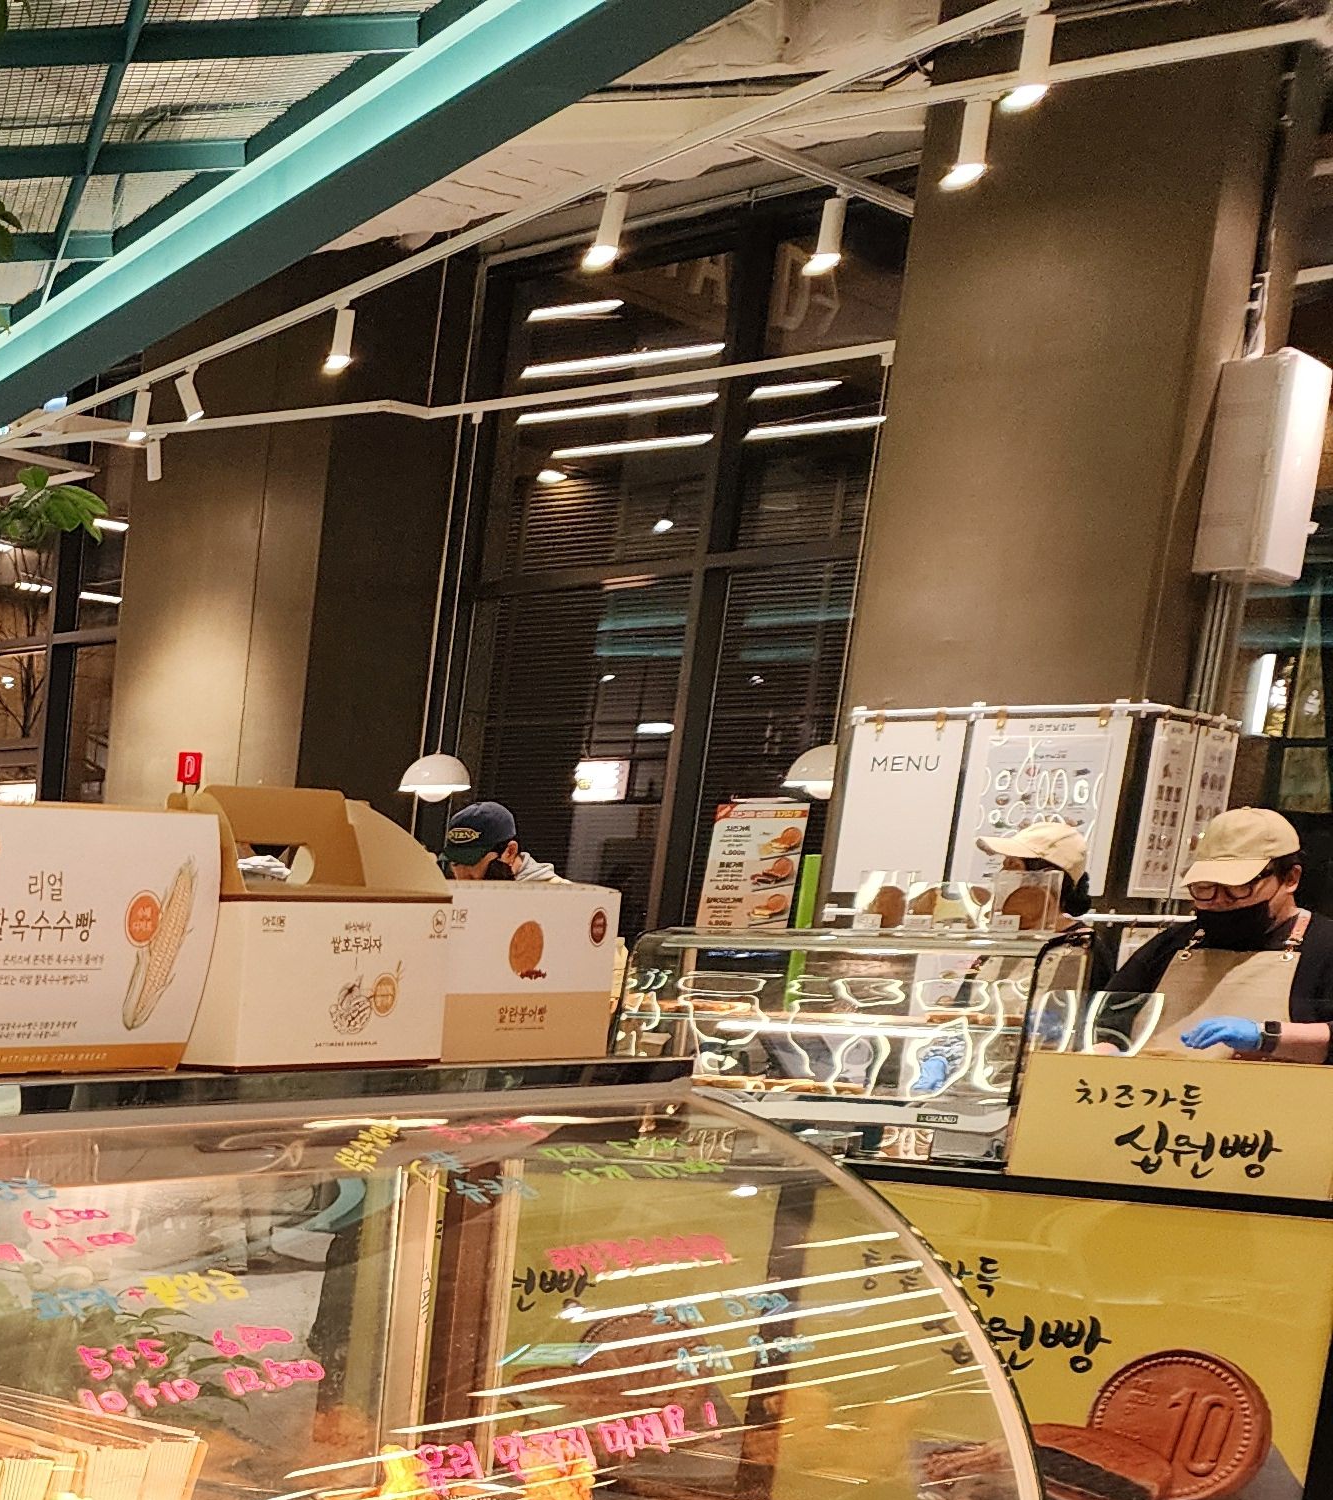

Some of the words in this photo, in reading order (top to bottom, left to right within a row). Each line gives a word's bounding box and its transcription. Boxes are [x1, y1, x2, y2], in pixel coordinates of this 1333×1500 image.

[871, 755, 941, 772] MENU
[28, 870, 63, 902] 리얼
[1074, 1079, 1205, 1121] 치즈가득
[1114, 1120, 1284, 1179] 십원빵
